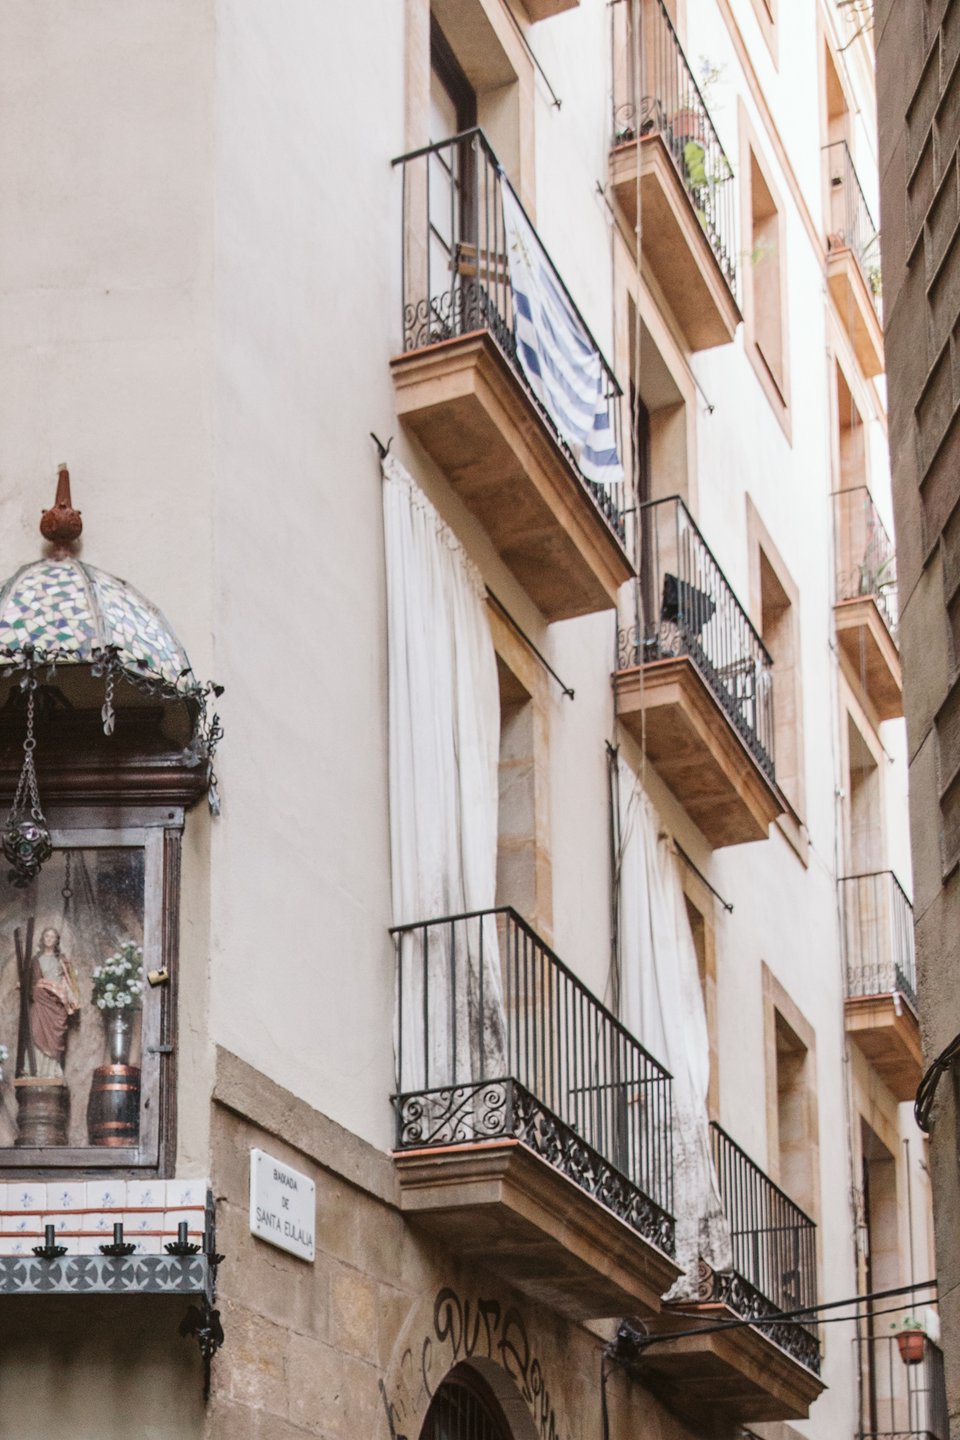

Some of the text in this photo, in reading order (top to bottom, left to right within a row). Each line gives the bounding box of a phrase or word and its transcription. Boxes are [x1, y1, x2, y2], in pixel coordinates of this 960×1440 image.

[272, 1168, 298, 1191] BAIXADA
[281, 1196, 290, 1210] DE
[255, 1206, 313, 1247] SANTA EULALIA
